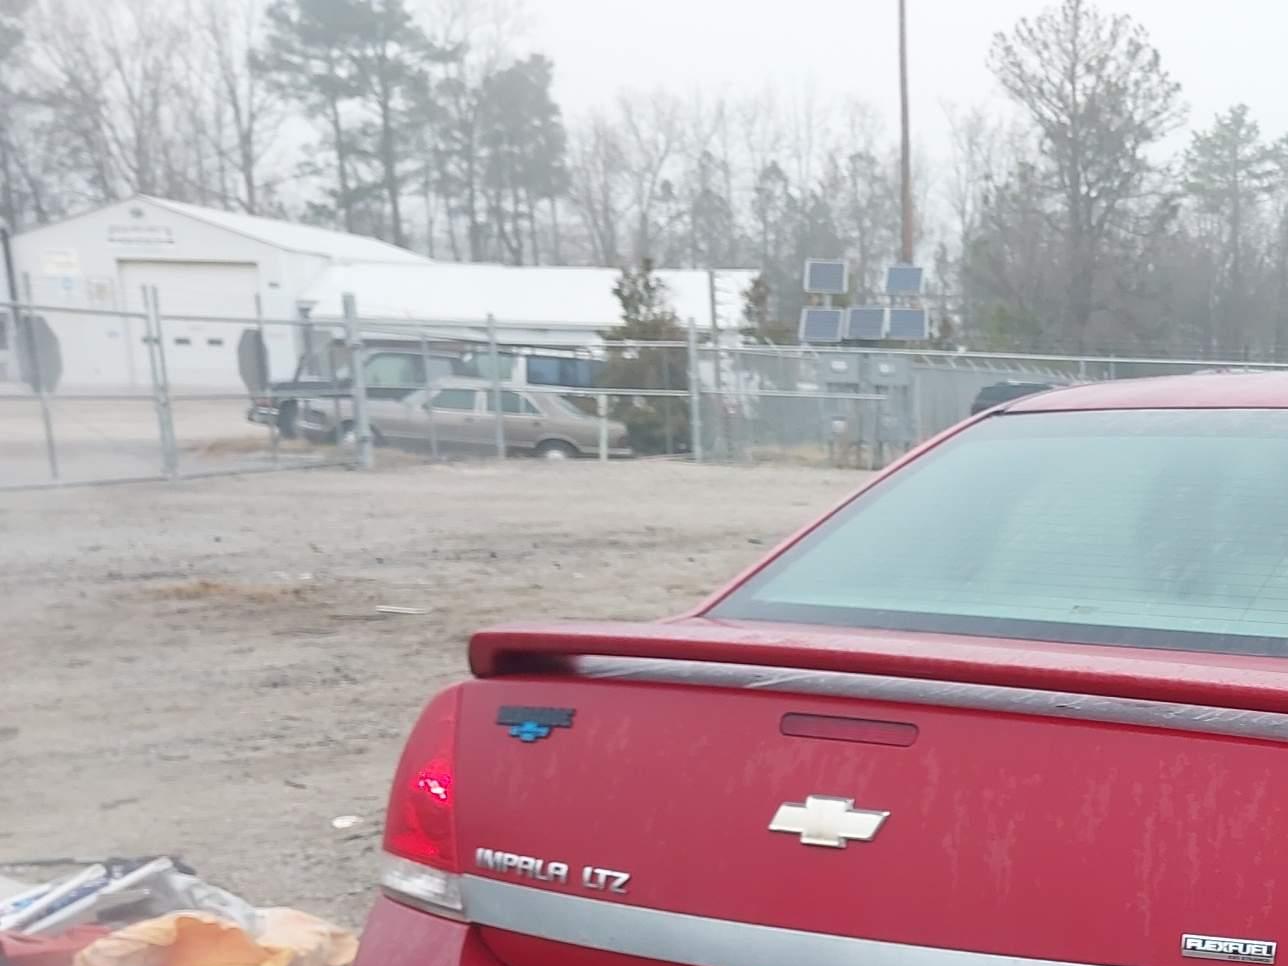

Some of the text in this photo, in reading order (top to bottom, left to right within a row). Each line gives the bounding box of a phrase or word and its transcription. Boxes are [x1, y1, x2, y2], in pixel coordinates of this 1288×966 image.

[475, 847, 631, 894] IMPALA LTZ
[1185, 937, 1273, 957] FLEXFUEL
